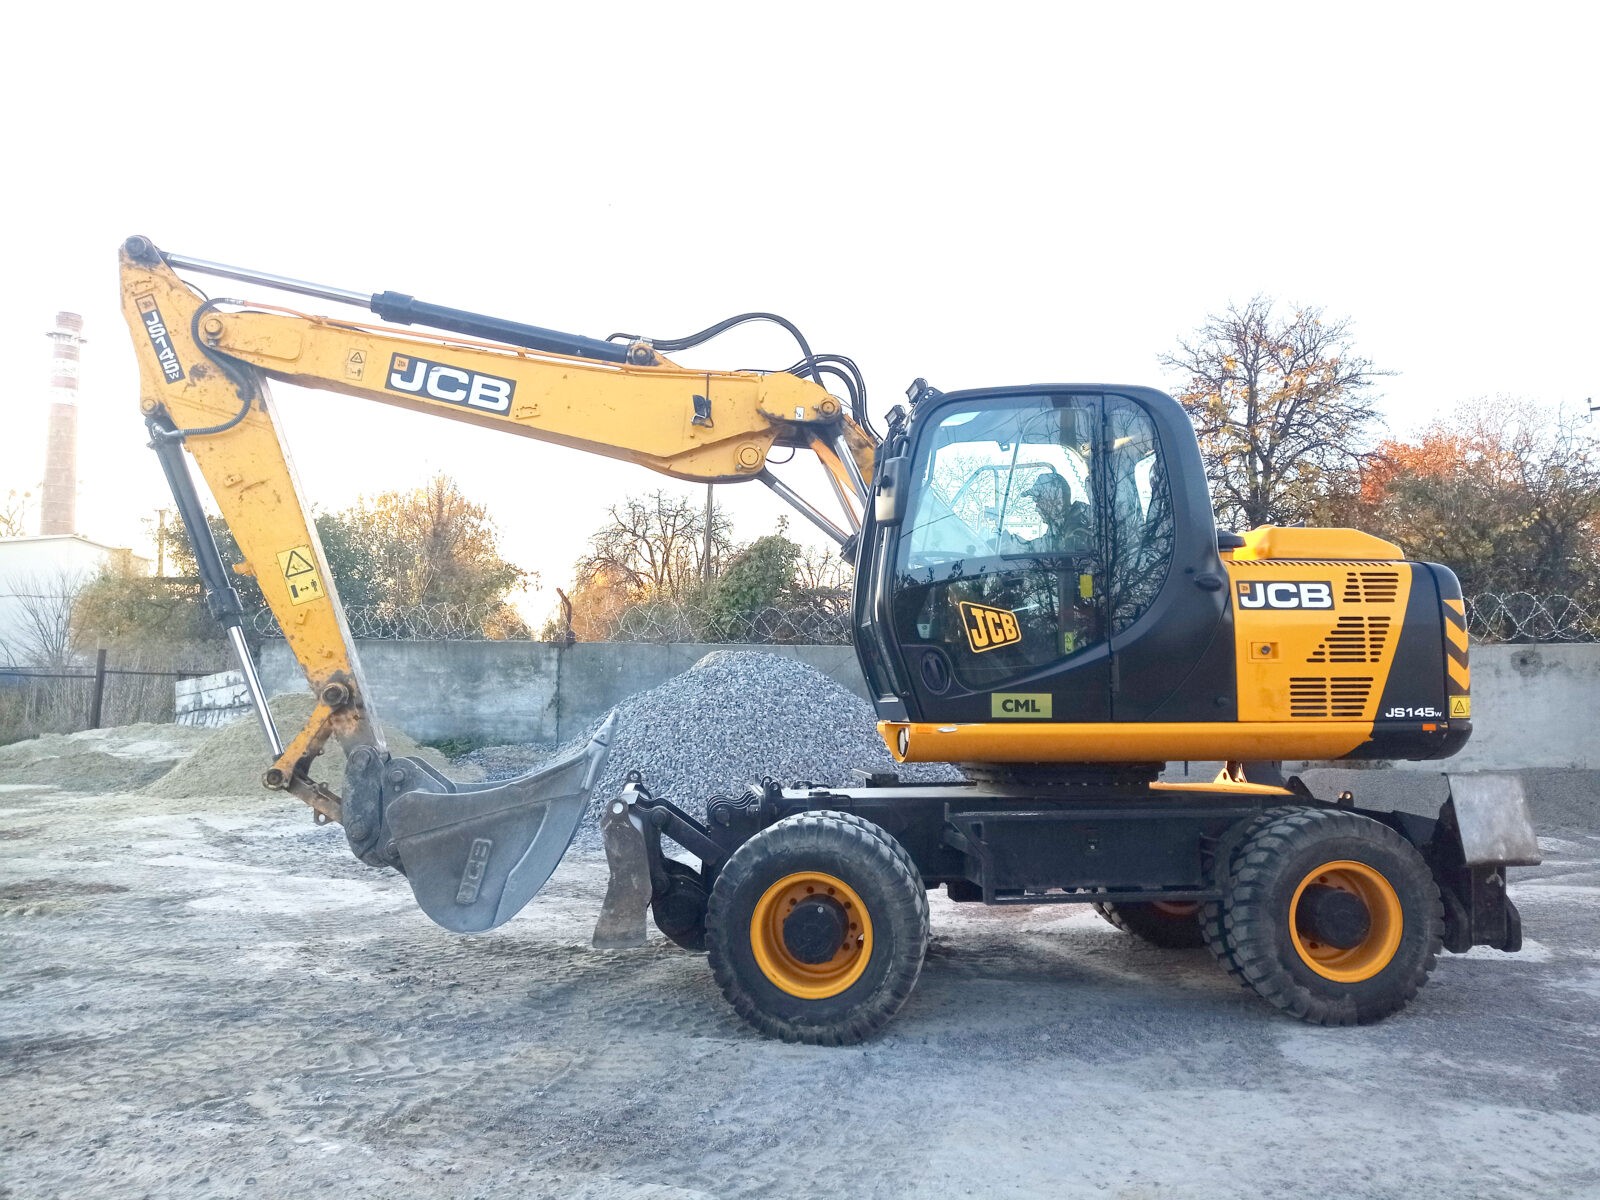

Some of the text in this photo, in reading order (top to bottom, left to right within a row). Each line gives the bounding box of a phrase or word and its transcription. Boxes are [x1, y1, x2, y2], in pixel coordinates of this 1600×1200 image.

[390, 361, 511, 411] JCB
[1240, 583, 1332, 608] JCB
[970, 607, 1017, 647] JCB
[1001, 699, 1041, 713] CML
